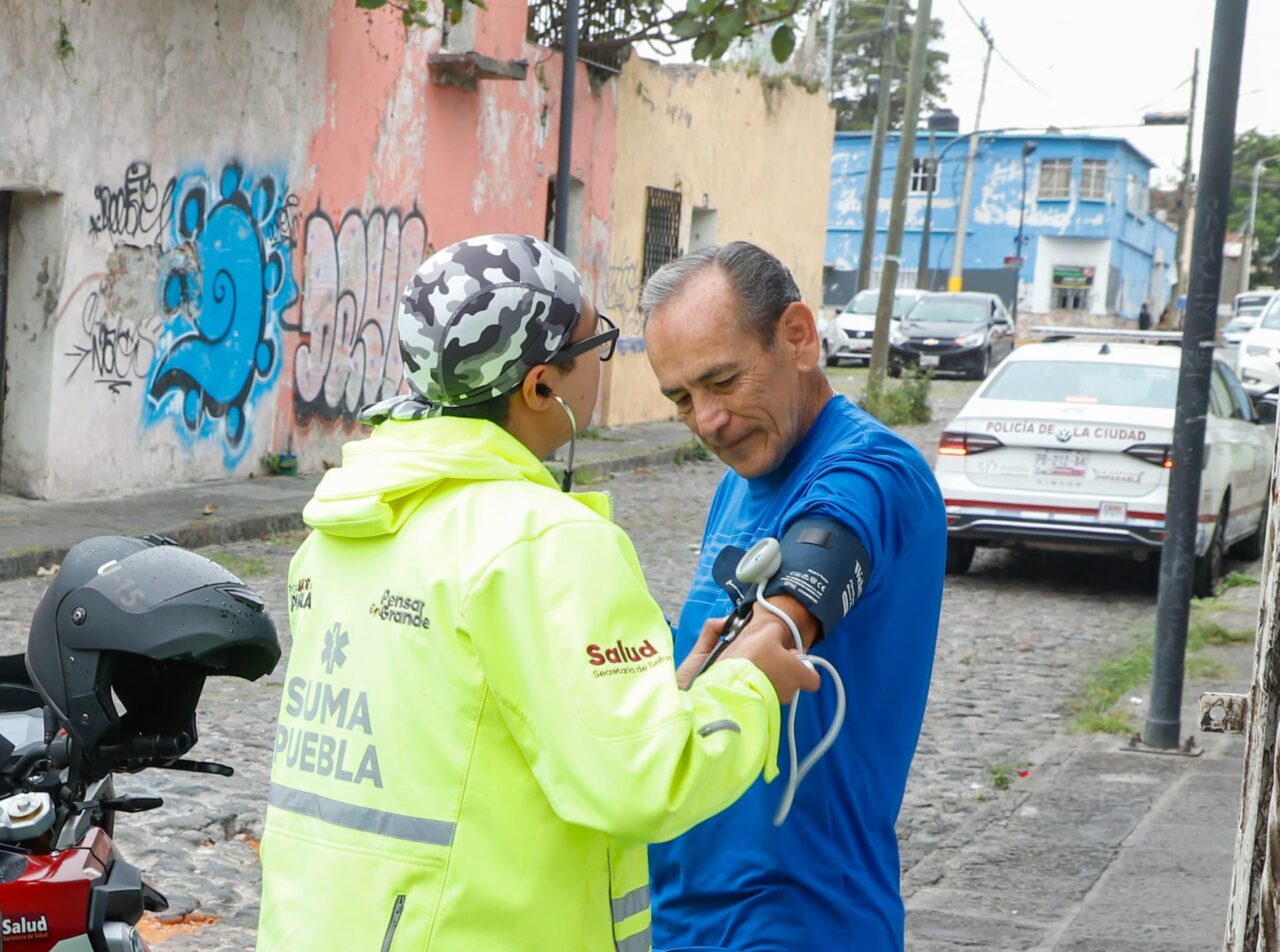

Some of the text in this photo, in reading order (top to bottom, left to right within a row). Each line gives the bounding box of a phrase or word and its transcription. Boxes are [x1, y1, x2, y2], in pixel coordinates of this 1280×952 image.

[986, 421, 1147, 441] POLICÍA DE LA CIUDAD
[380, 588, 425, 613] Pensar
[378, 604, 430, 629] Grande
[586, 639, 658, 666] Salud
[285, 676, 373, 735] SUMA
[273, 724, 384, 789] PUEBLA
[1, 915, 48, 935] Salud
